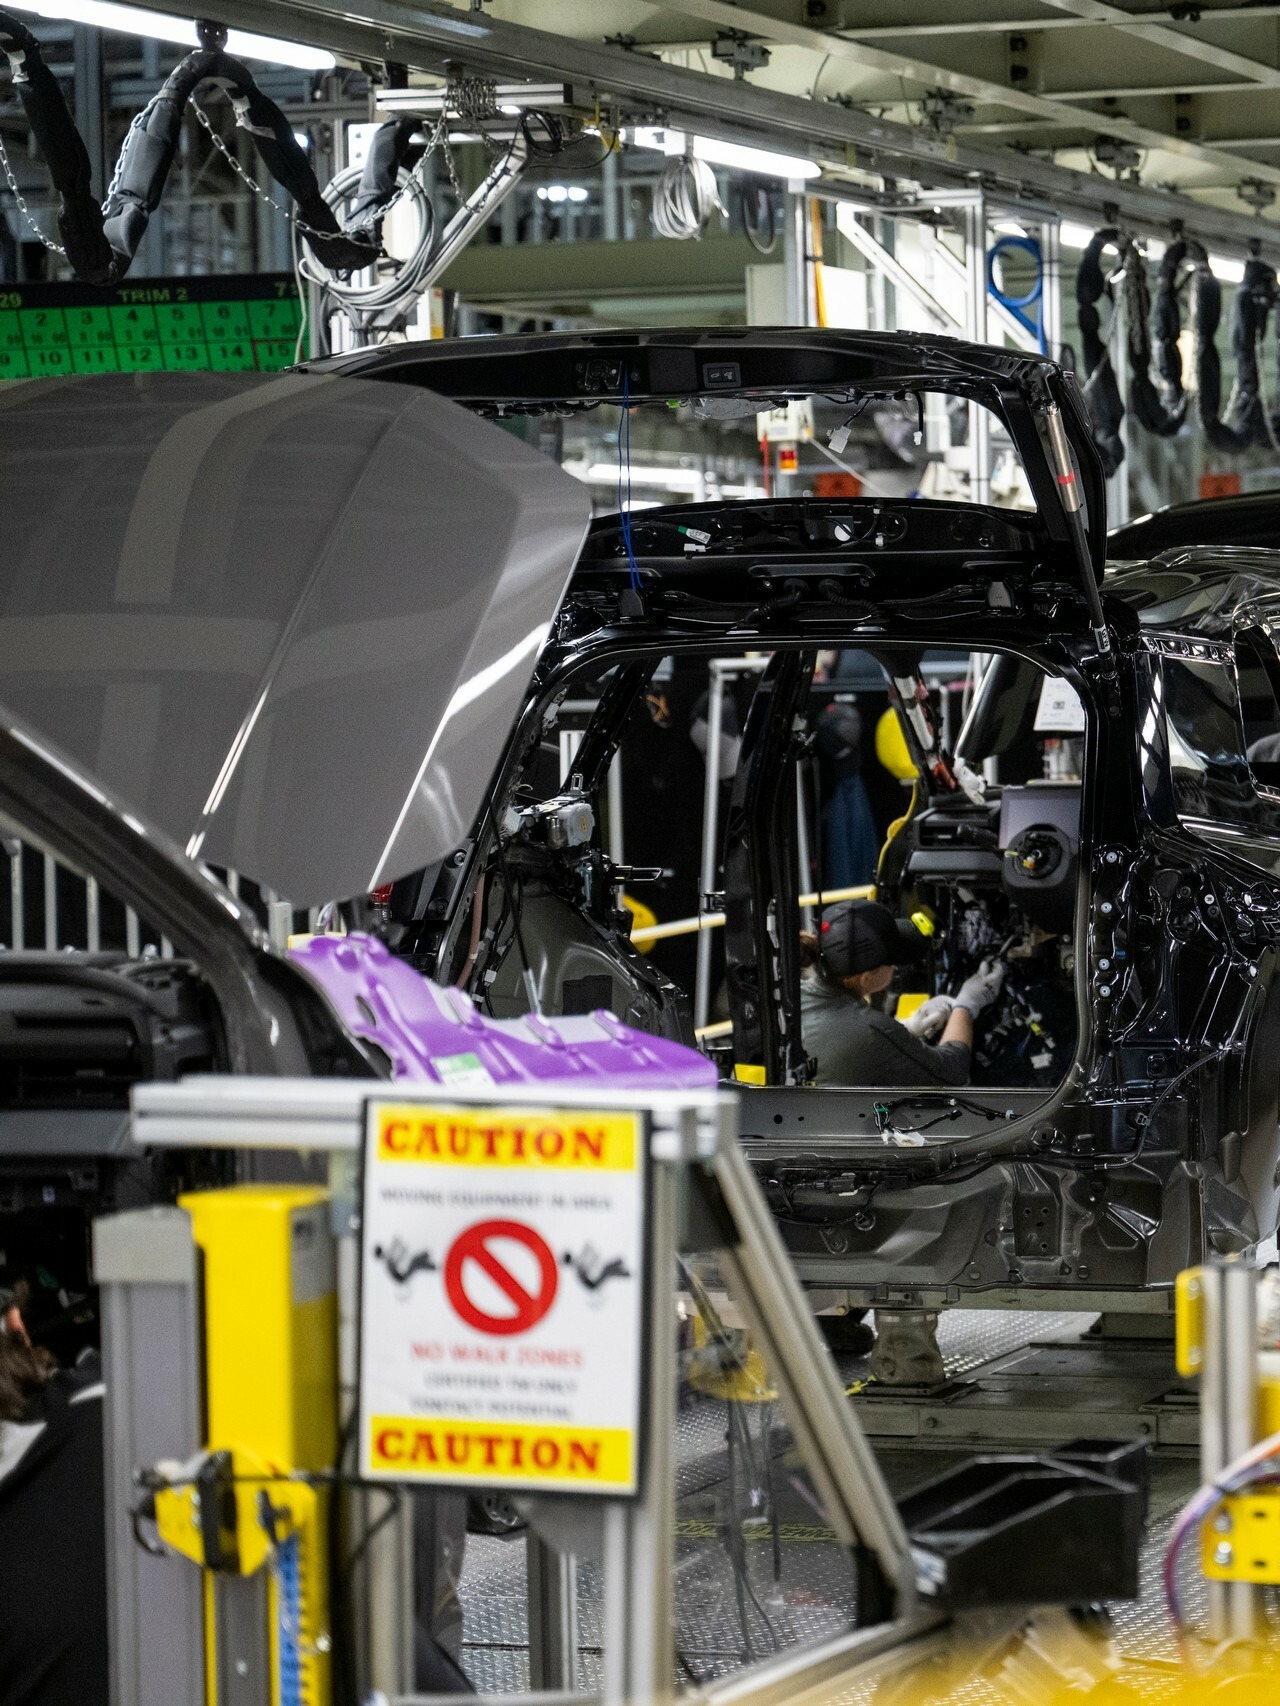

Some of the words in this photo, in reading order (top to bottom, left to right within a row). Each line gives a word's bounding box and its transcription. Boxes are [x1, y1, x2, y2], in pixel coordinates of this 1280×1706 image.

[117, 288, 170, 303] TRIM
[177, 287, 189, 301] 2
[126, 309, 139, 323] 4
[217, 304, 230, 320] 6
[264, 303, 276, 317] 7
[34, 311, 47, 327] 2
[80, 310, 94, 325] 3
[84, 350, 104, 363] 11
[129, 348, 151, 362] 12
[174, 346, 198, 360] 13
[221, 345, 243, 359] 14
[267, 343, 290, 358] 15
[39, 351, 62, 365] 10
[382, 1121, 605, 1161] CAUTION
[375, 1428, 601, 1473] CAUTION
